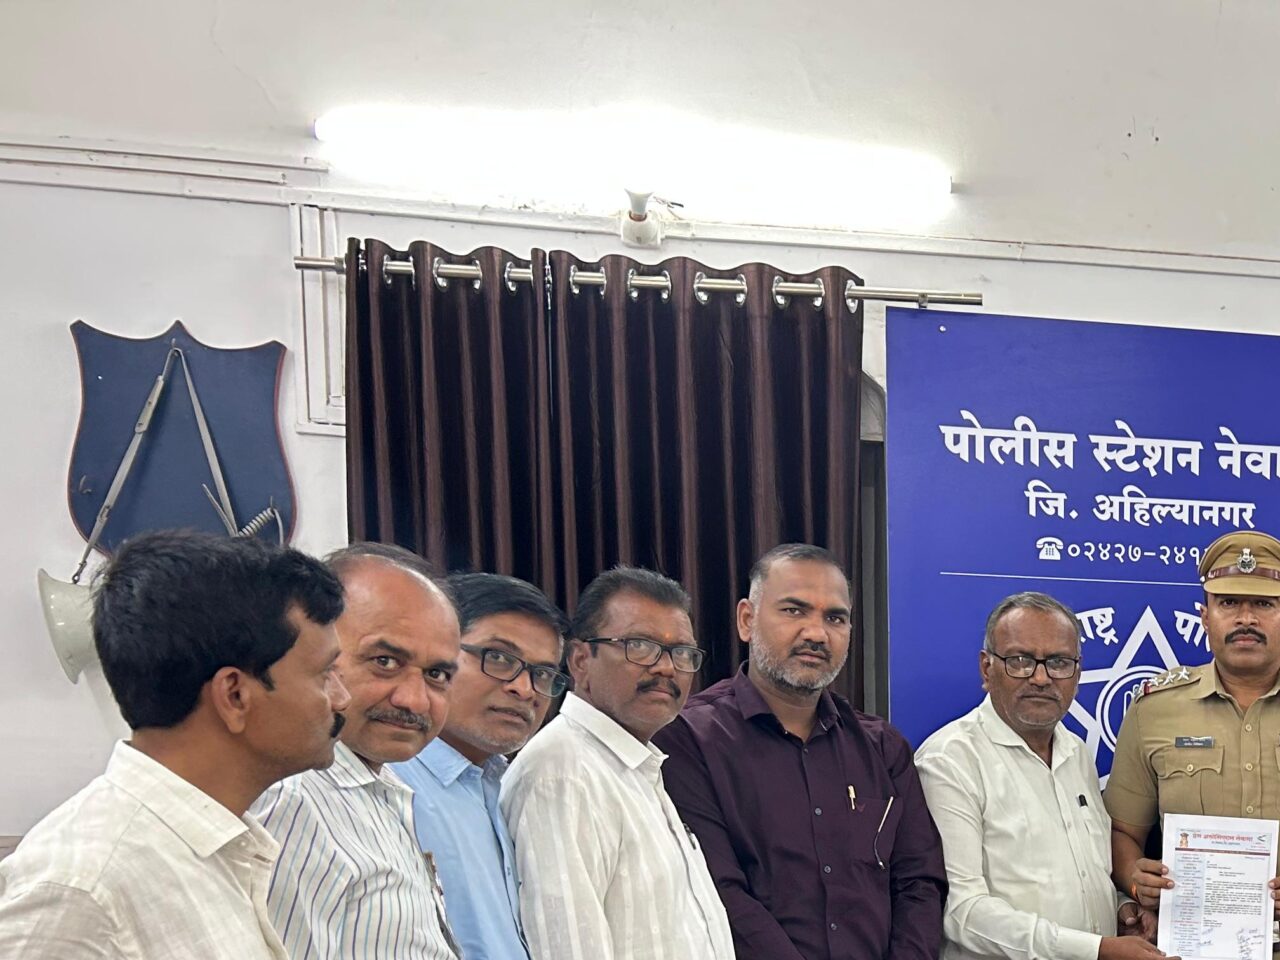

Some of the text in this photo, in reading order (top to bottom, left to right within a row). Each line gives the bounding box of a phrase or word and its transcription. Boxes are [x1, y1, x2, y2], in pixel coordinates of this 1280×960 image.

[939, 409, 1077, 469] पोलीस
[1089, 419, 1203, 476] स्टेशन
[1025, 480, 1256, 529] जि. अहिल्यानगर
[1067, 542, 1201, 566] ०२४२७-२४१
